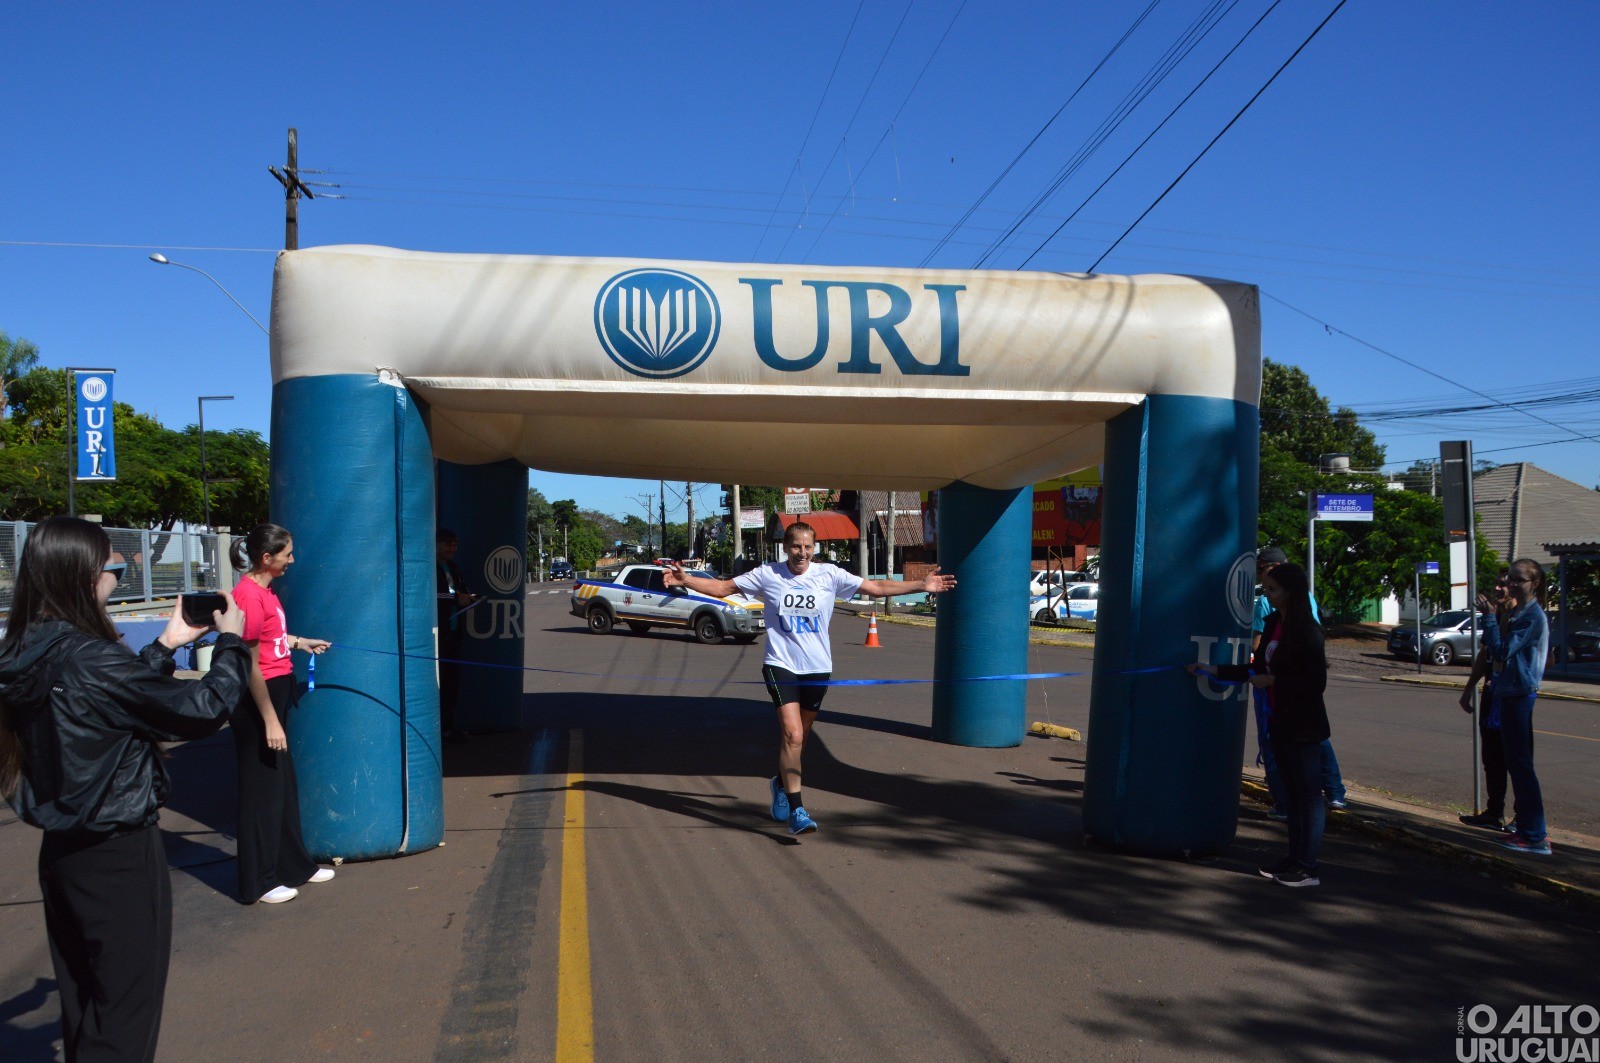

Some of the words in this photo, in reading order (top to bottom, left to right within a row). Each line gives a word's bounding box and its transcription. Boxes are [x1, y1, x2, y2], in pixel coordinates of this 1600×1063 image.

[739, 278, 971, 377] URI
[84, 406, 106, 476] URI
[1033, 500, 1055, 513] CADO
[465, 599, 526, 640] UR
[784, 594, 815, 610] 028
